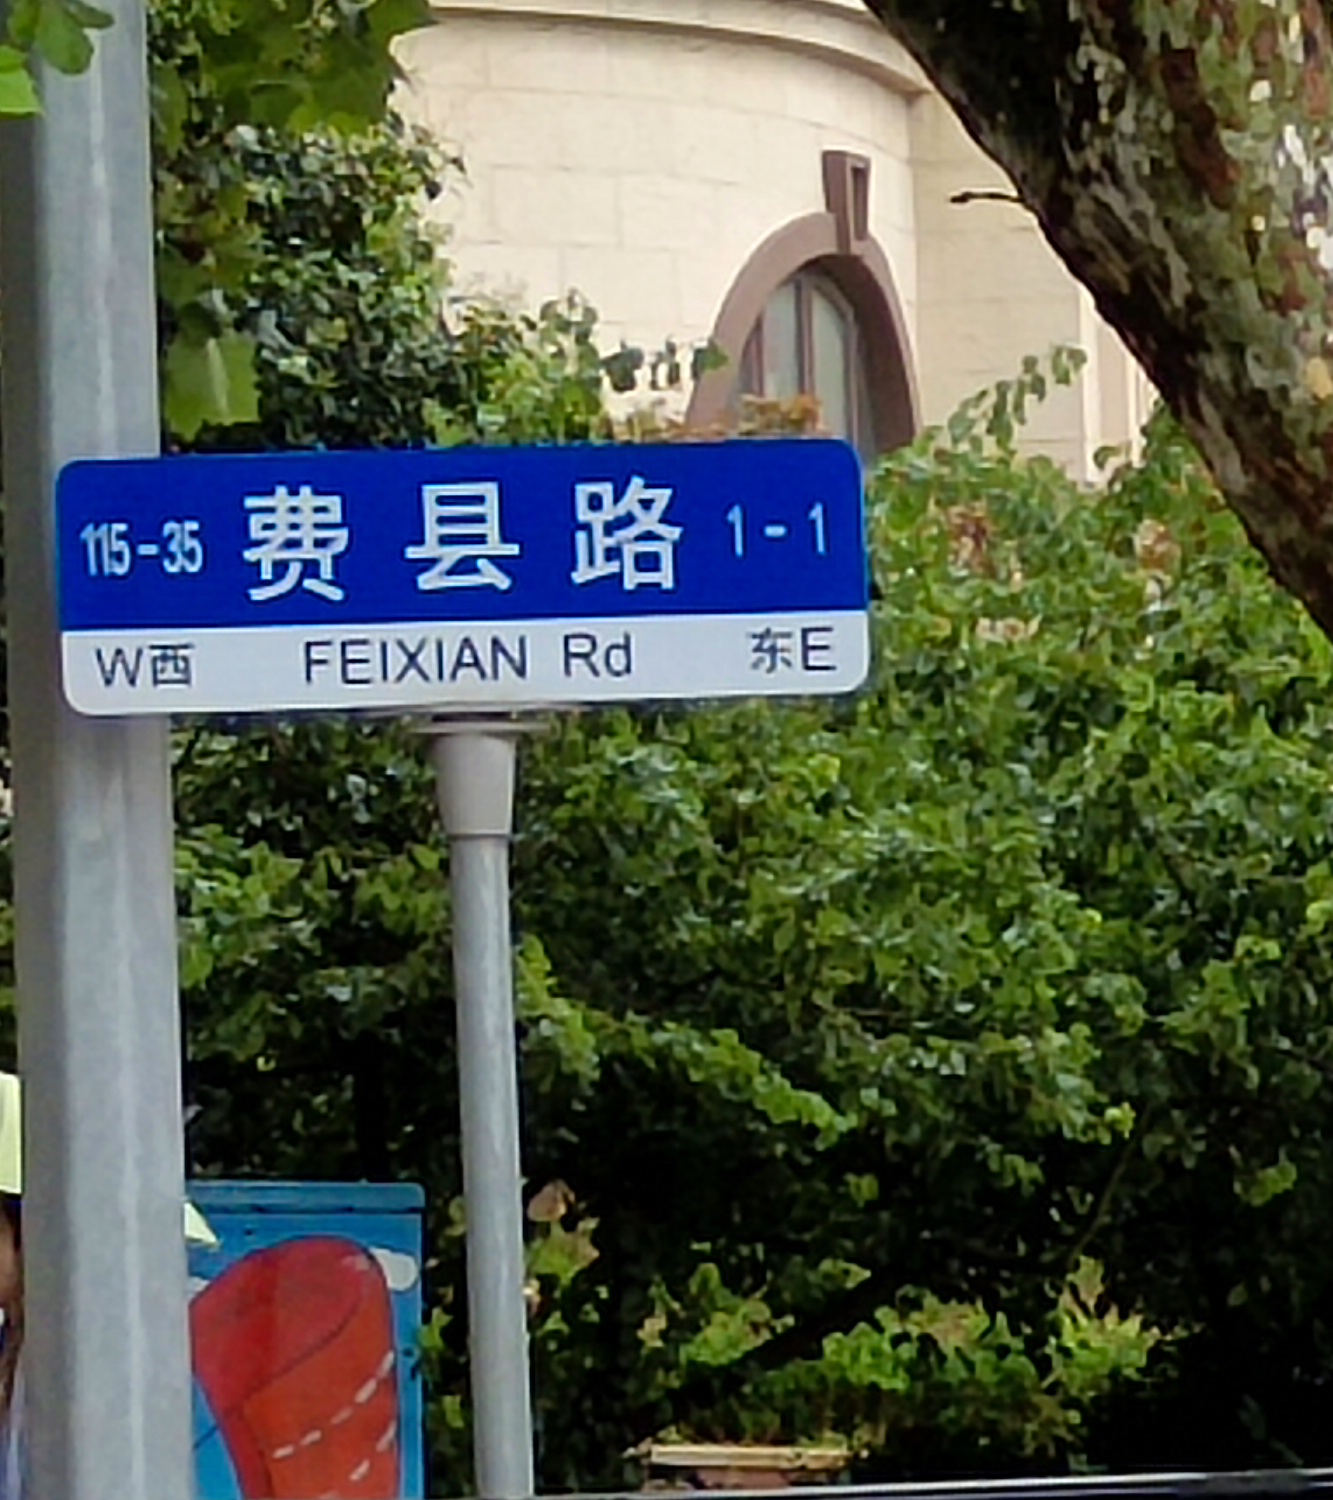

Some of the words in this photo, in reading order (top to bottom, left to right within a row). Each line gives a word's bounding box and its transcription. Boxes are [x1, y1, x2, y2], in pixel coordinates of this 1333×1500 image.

[80, 520, 203, 577] 115-35
[243, 474, 684, 601] 费县路
[726, 501, 827, 558] 1-1
[303, 633, 528, 685] FEIXIAN
[563, 631, 633, 678] Rd
